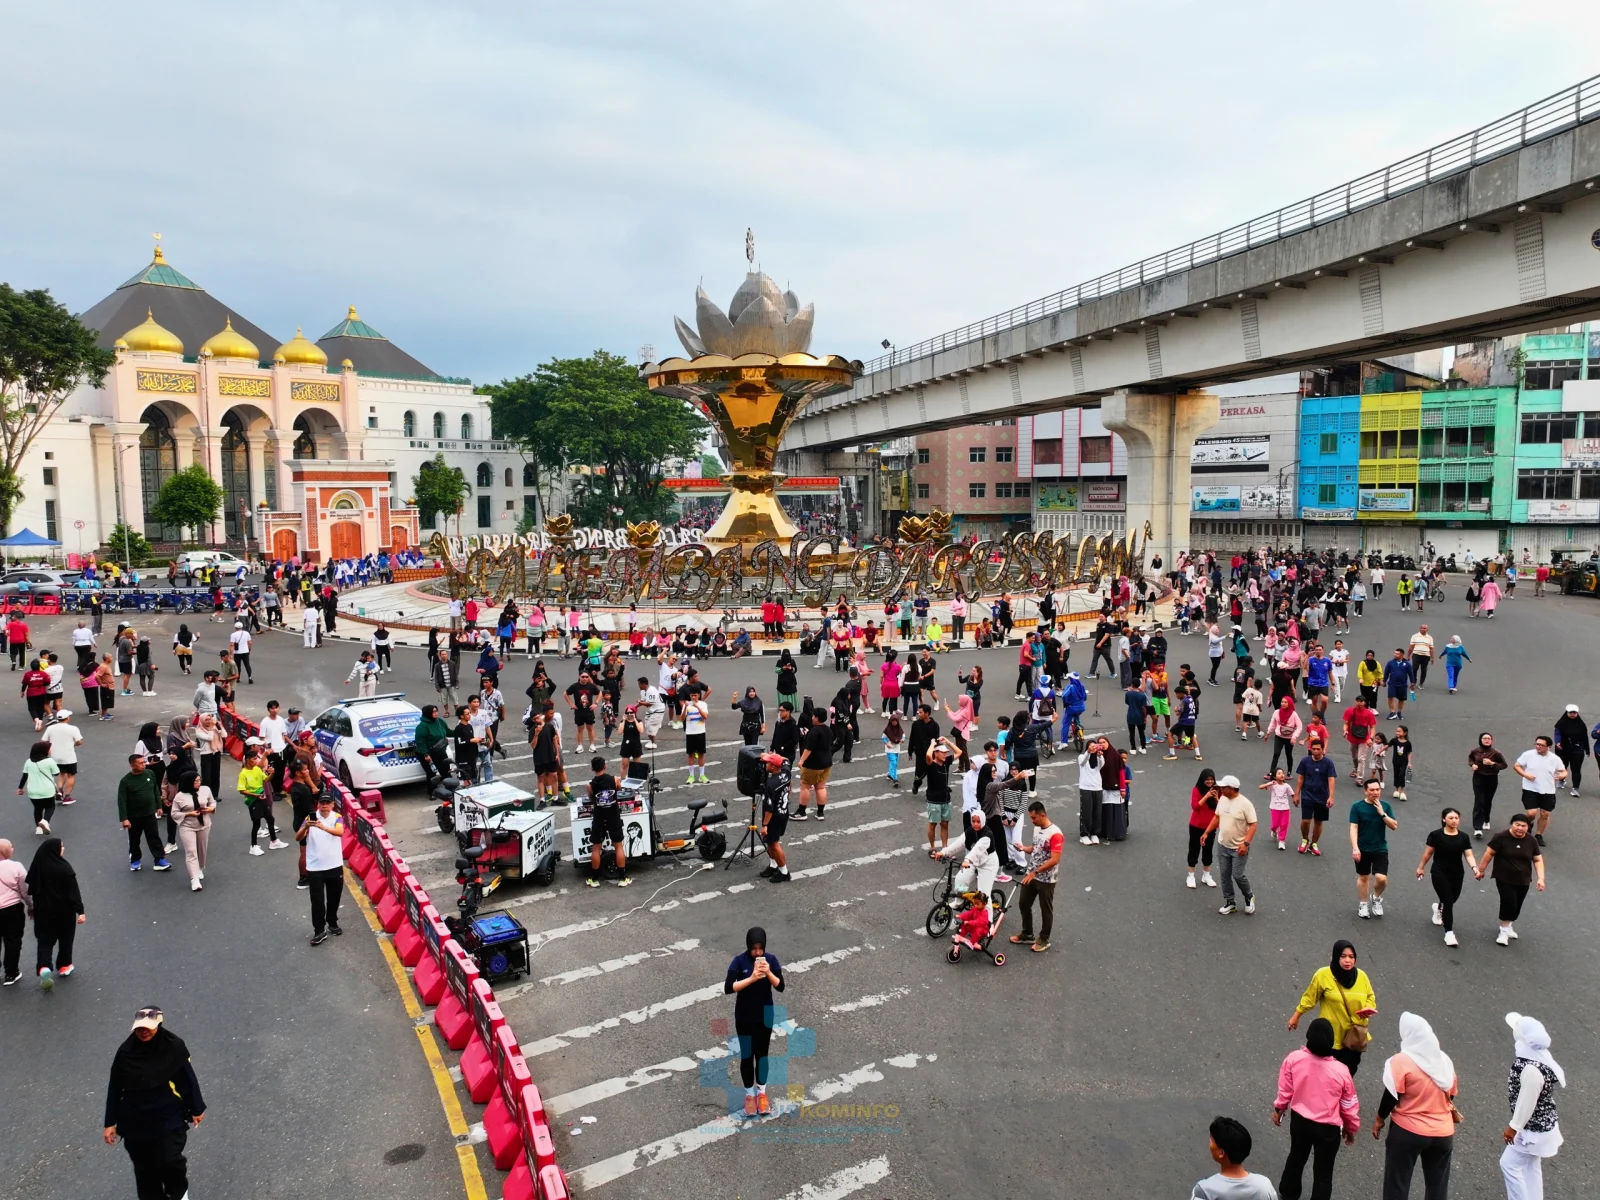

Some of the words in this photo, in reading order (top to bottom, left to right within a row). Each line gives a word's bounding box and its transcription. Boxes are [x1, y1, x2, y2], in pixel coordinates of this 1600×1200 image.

[1220, 406, 1266, 416] PERKASA
[465, 531, 843, 611] PALEMBANG
[851, 520, 1153, 603] DARUSSALAM
[535, 820, 552, 840] BUTUH
[534, 835, 546, 851] KOPI
